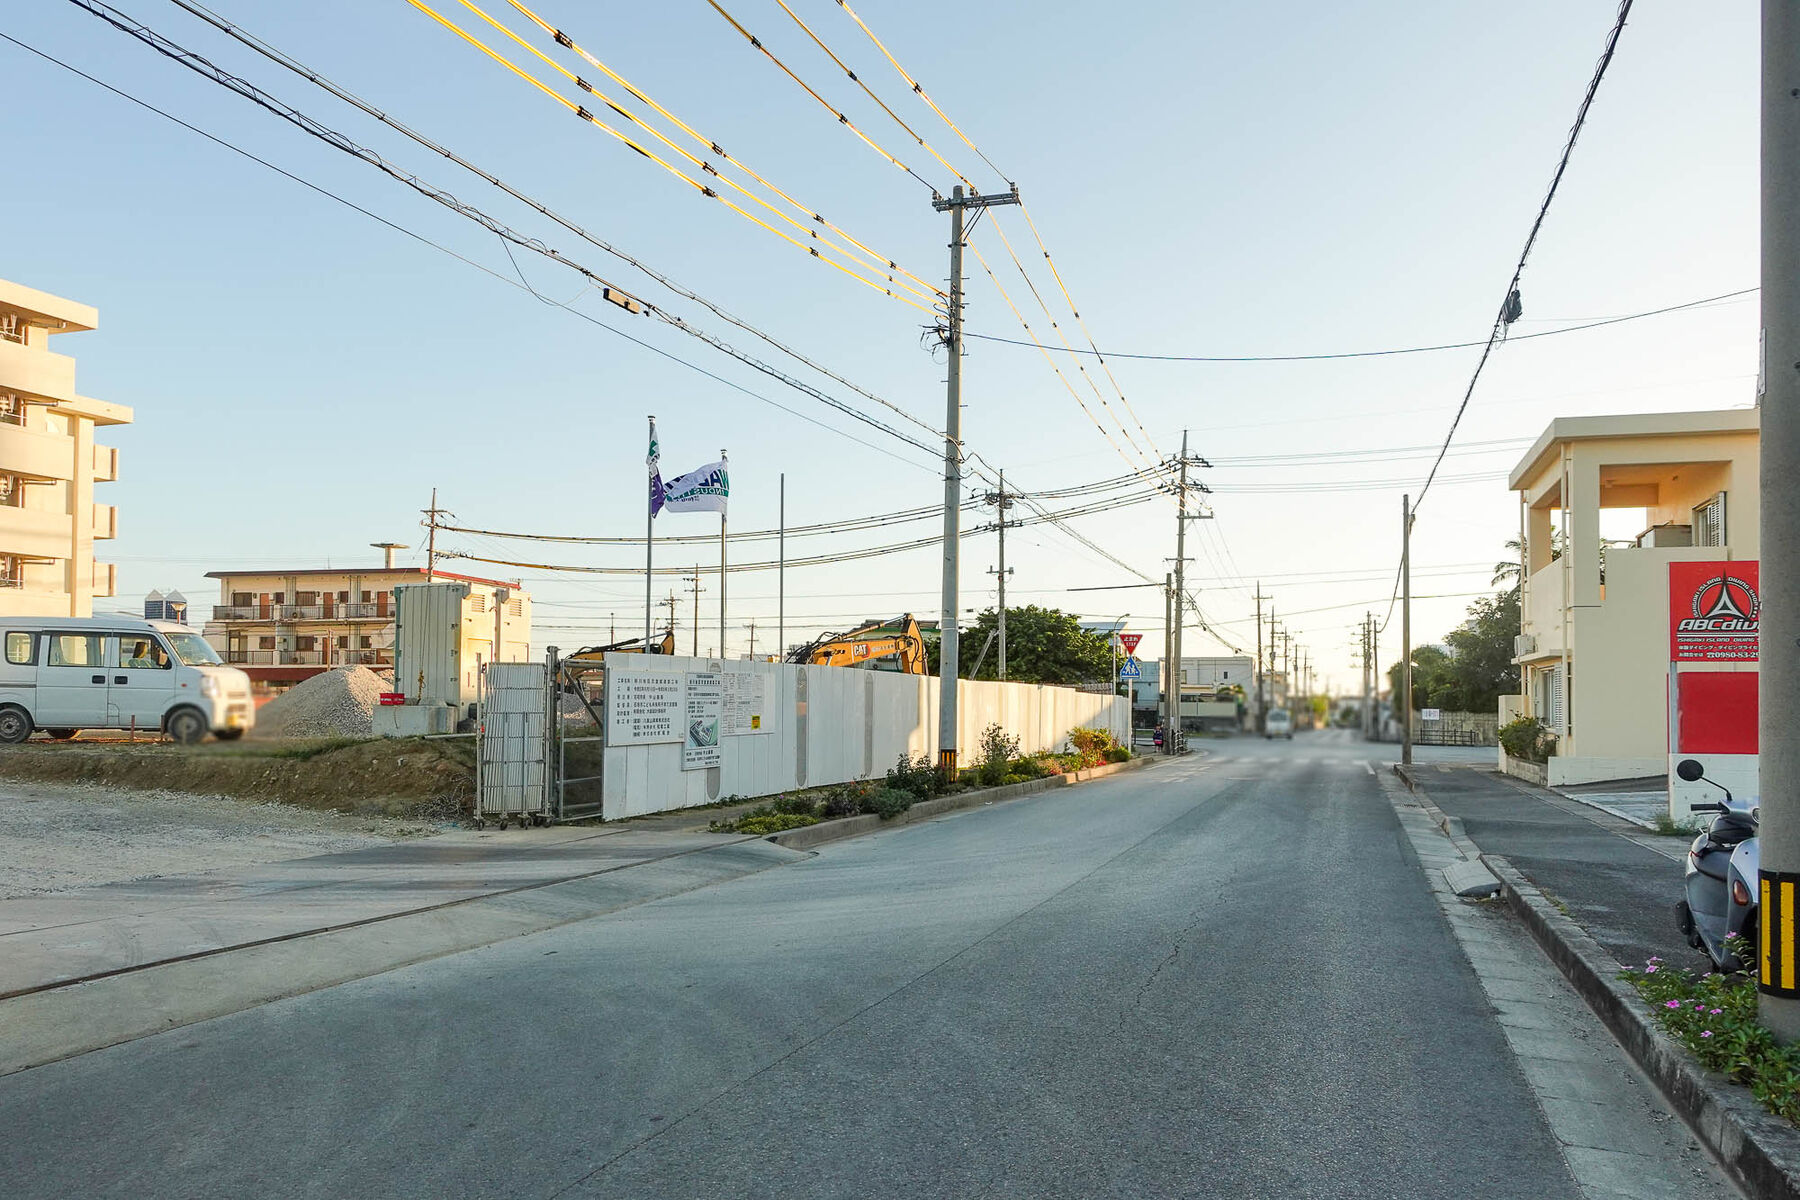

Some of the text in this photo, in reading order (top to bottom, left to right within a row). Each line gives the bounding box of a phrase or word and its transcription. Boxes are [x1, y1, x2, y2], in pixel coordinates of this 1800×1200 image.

[1699, 576, 1722, 592] ISLAND
[1728, 576, 1750, 590] DIVING
[854, 644, 868, 656] CAT
